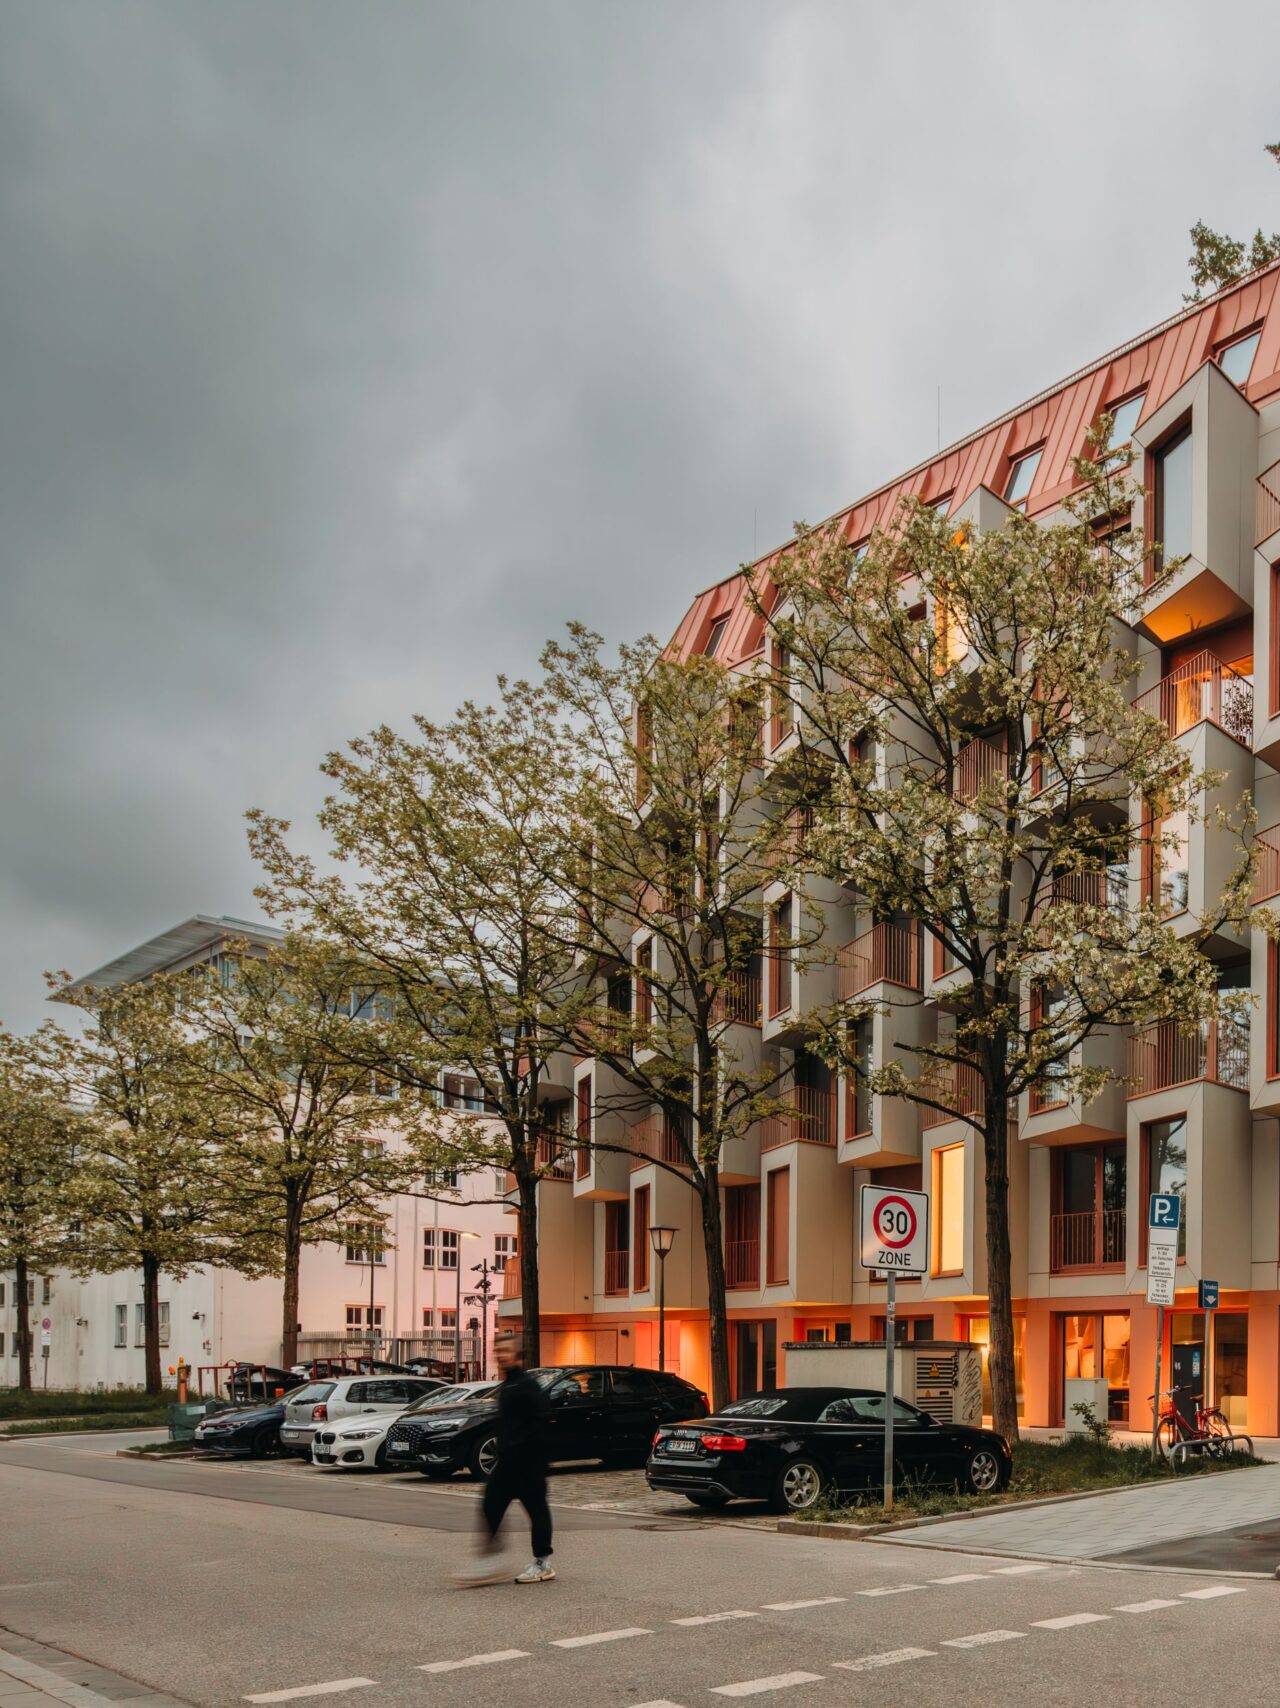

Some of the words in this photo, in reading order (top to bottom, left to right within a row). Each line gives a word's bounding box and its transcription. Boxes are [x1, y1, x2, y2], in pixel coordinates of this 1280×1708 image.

[882, 1209, 908, 1235] 30
[1154, 1198, 1171, 1223] P
[878, 1250, 911, 1266] ZONE
